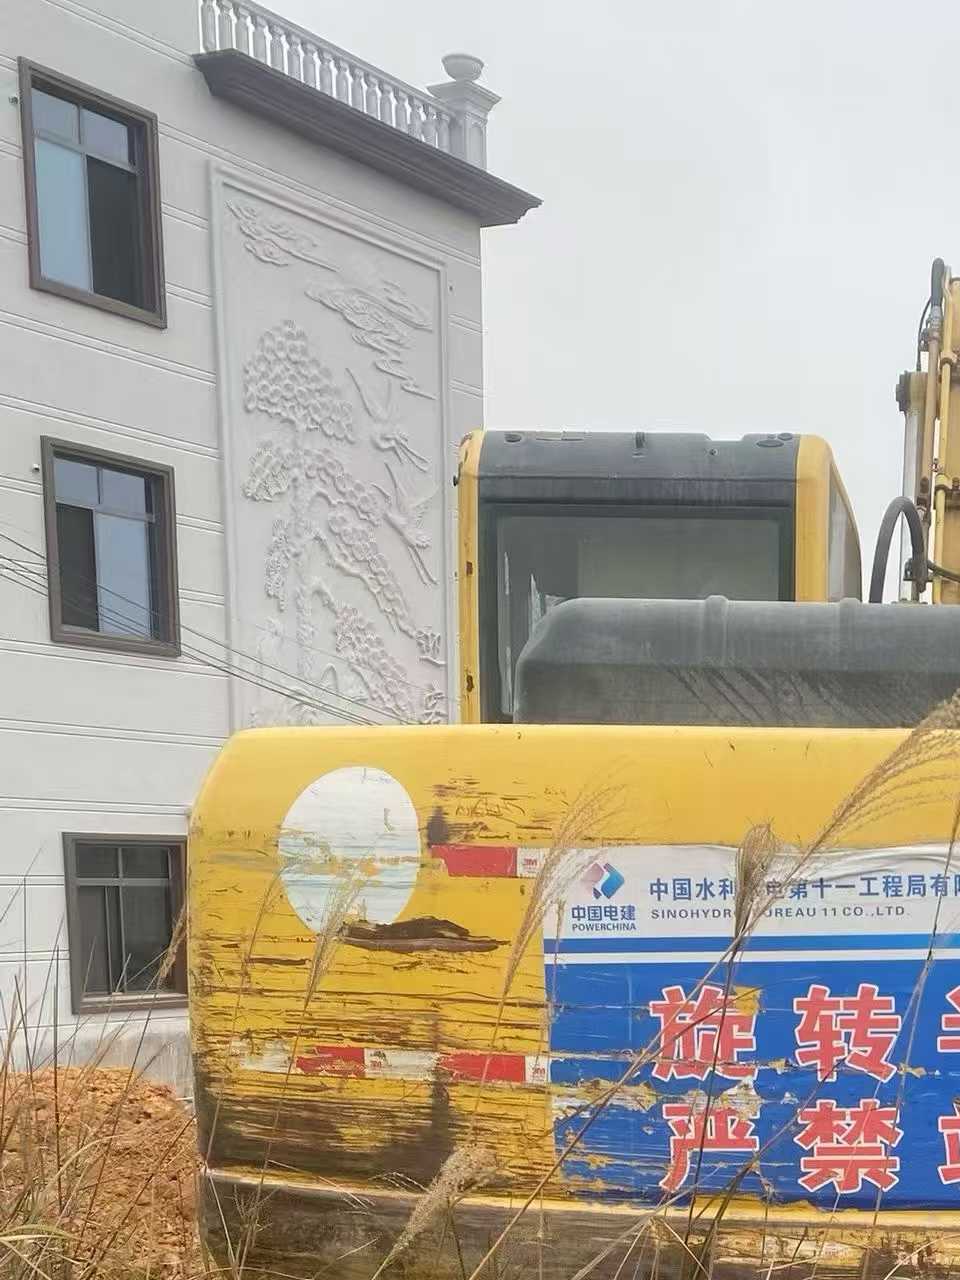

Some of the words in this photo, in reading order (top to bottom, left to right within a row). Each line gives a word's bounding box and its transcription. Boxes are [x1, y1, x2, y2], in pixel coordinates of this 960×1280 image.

[571, 904, 636, 921] 中国电建
[651, 908, 736, 920] SINOHYDR
[757, 906, 816, 918] UREAU
[572, 922, 637, 931] POWERCHINA
